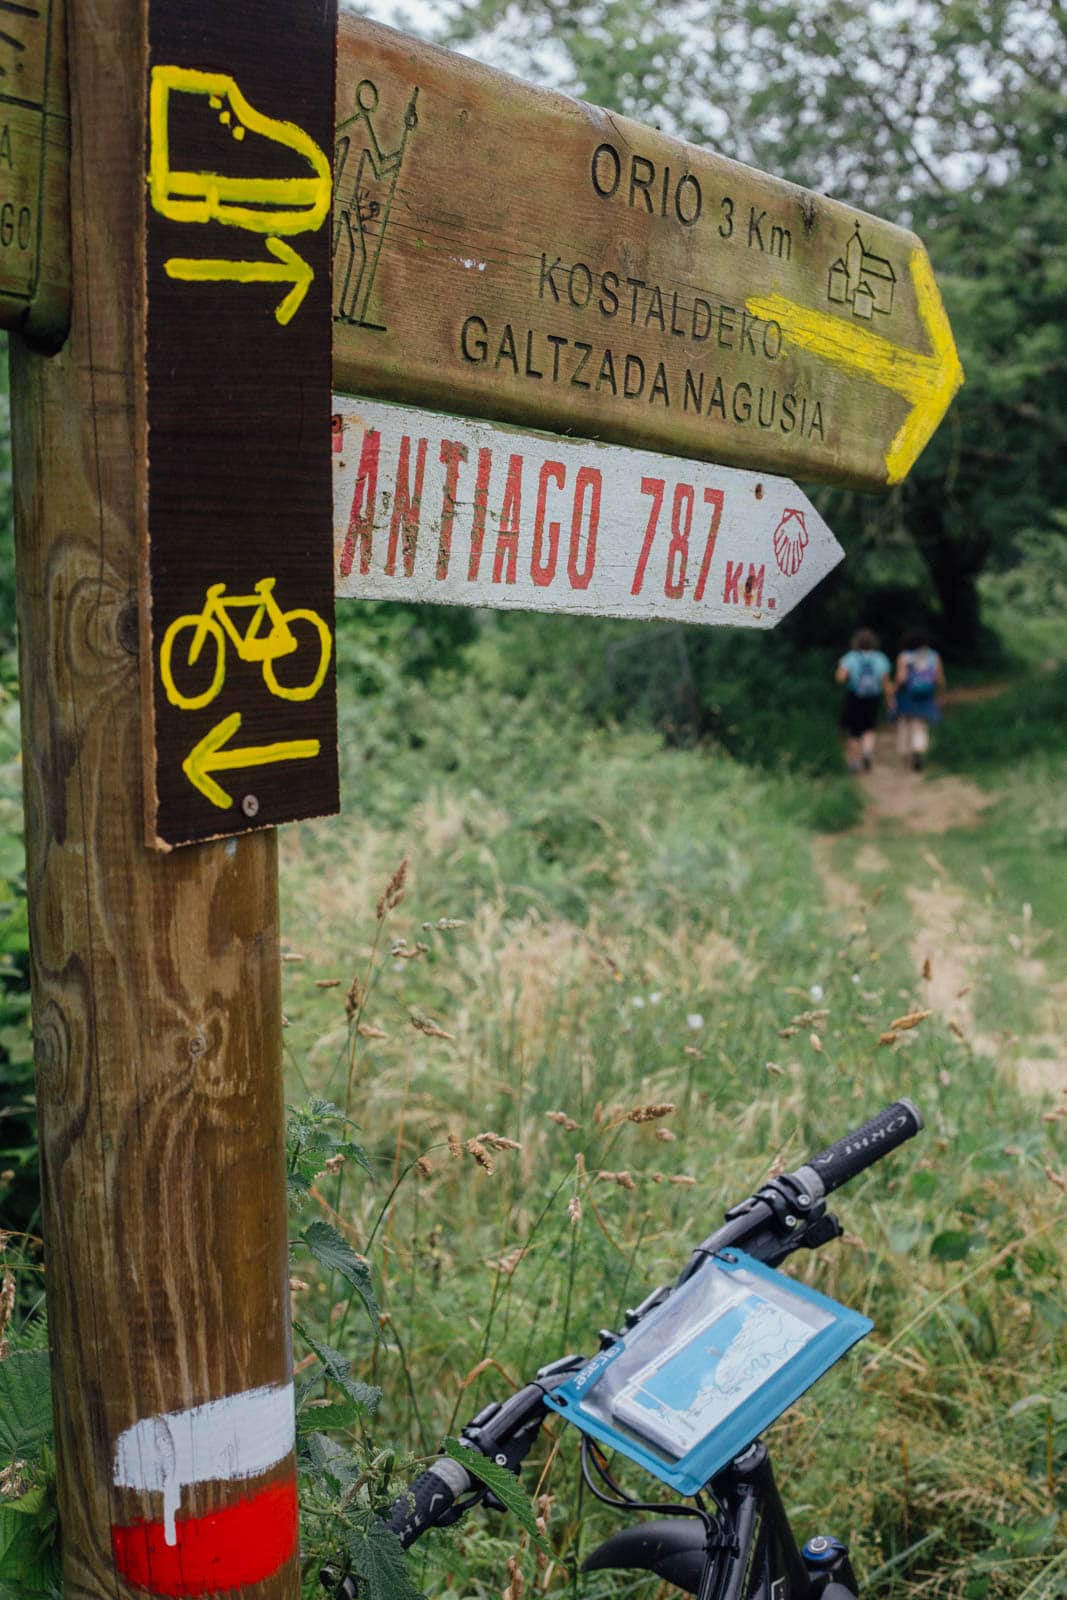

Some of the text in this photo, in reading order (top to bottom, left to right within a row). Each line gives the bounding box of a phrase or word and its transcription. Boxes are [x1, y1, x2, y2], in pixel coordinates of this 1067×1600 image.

[591, 143, 792, 261] ORIO 3 Km
[538, 252, 783, 361] KOSTALDEKO
[460, 315, 825, 441] GALTZADA NAGUSIA
[332, 428, 603, 590] ANTIAGO
[630, 476, 725, 602] 787
